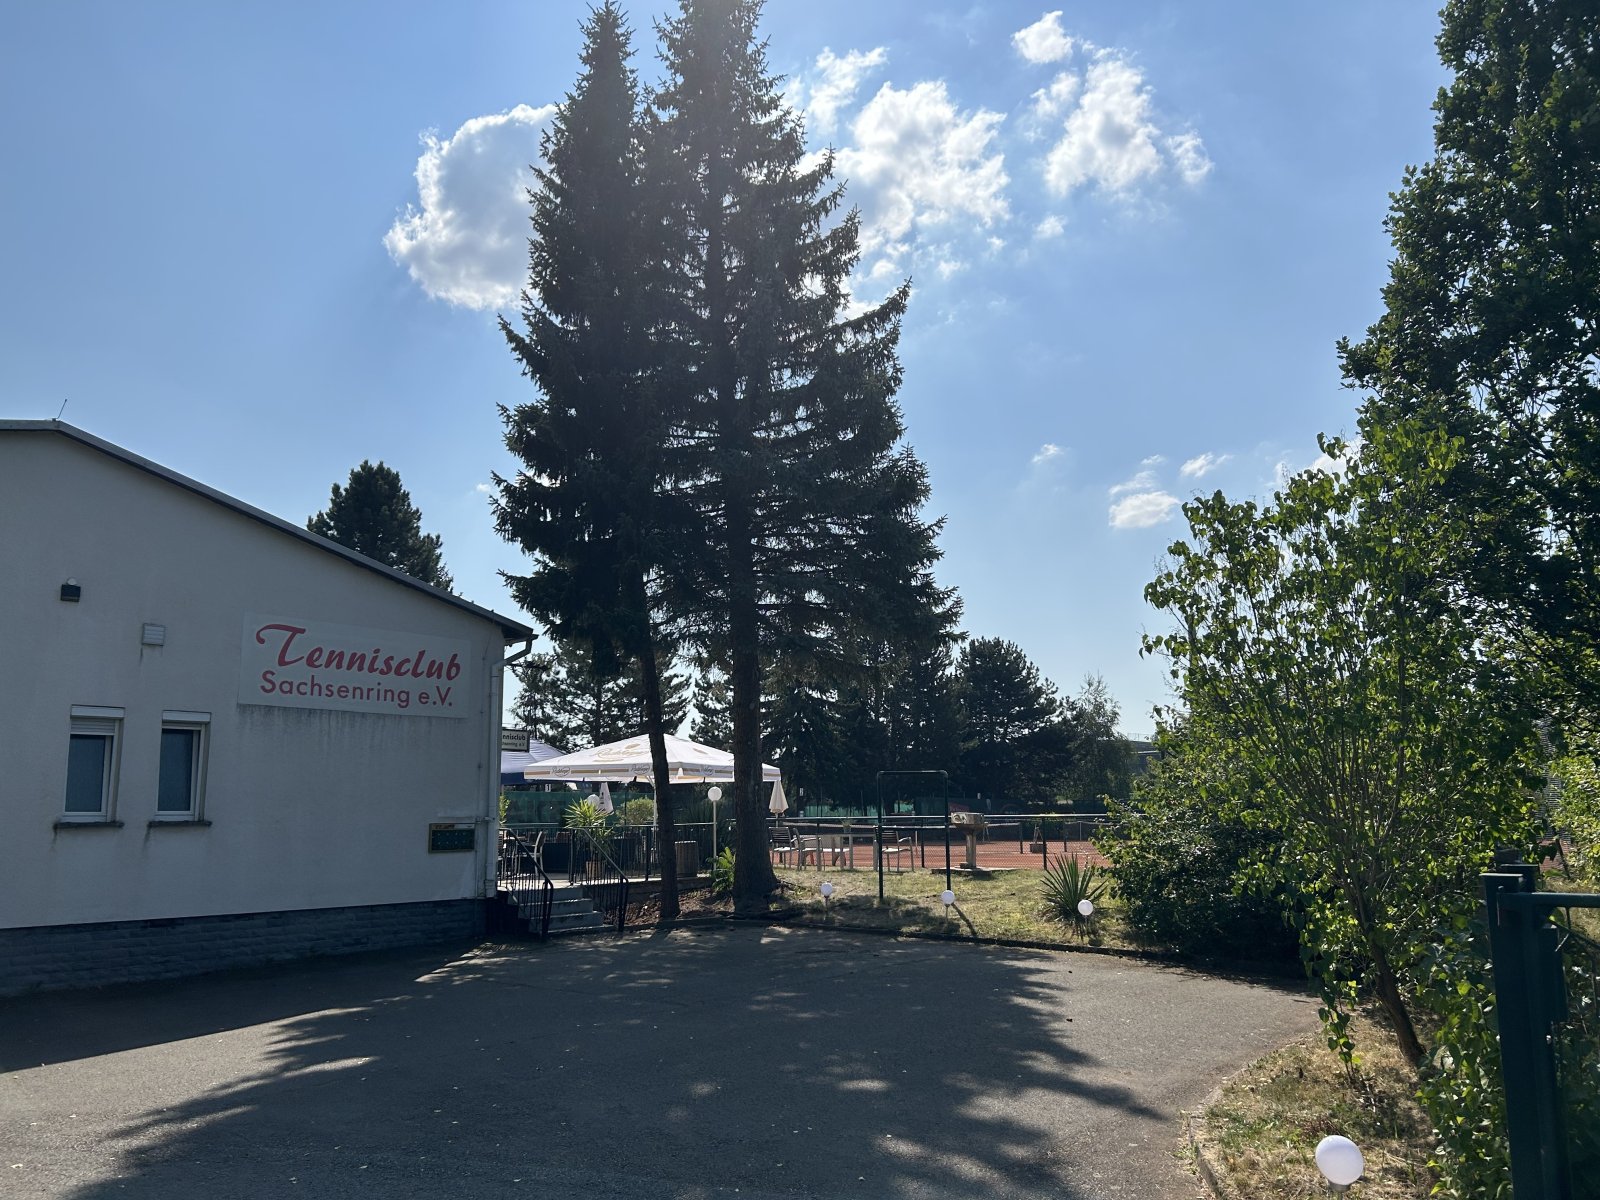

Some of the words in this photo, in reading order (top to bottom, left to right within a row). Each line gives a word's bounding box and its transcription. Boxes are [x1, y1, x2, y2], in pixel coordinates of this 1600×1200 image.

[255, 623, 461, 681] Tennisclub
[260, 670, 410, 709] Sachsenring
[418, 685, 453, 707] e.V.
